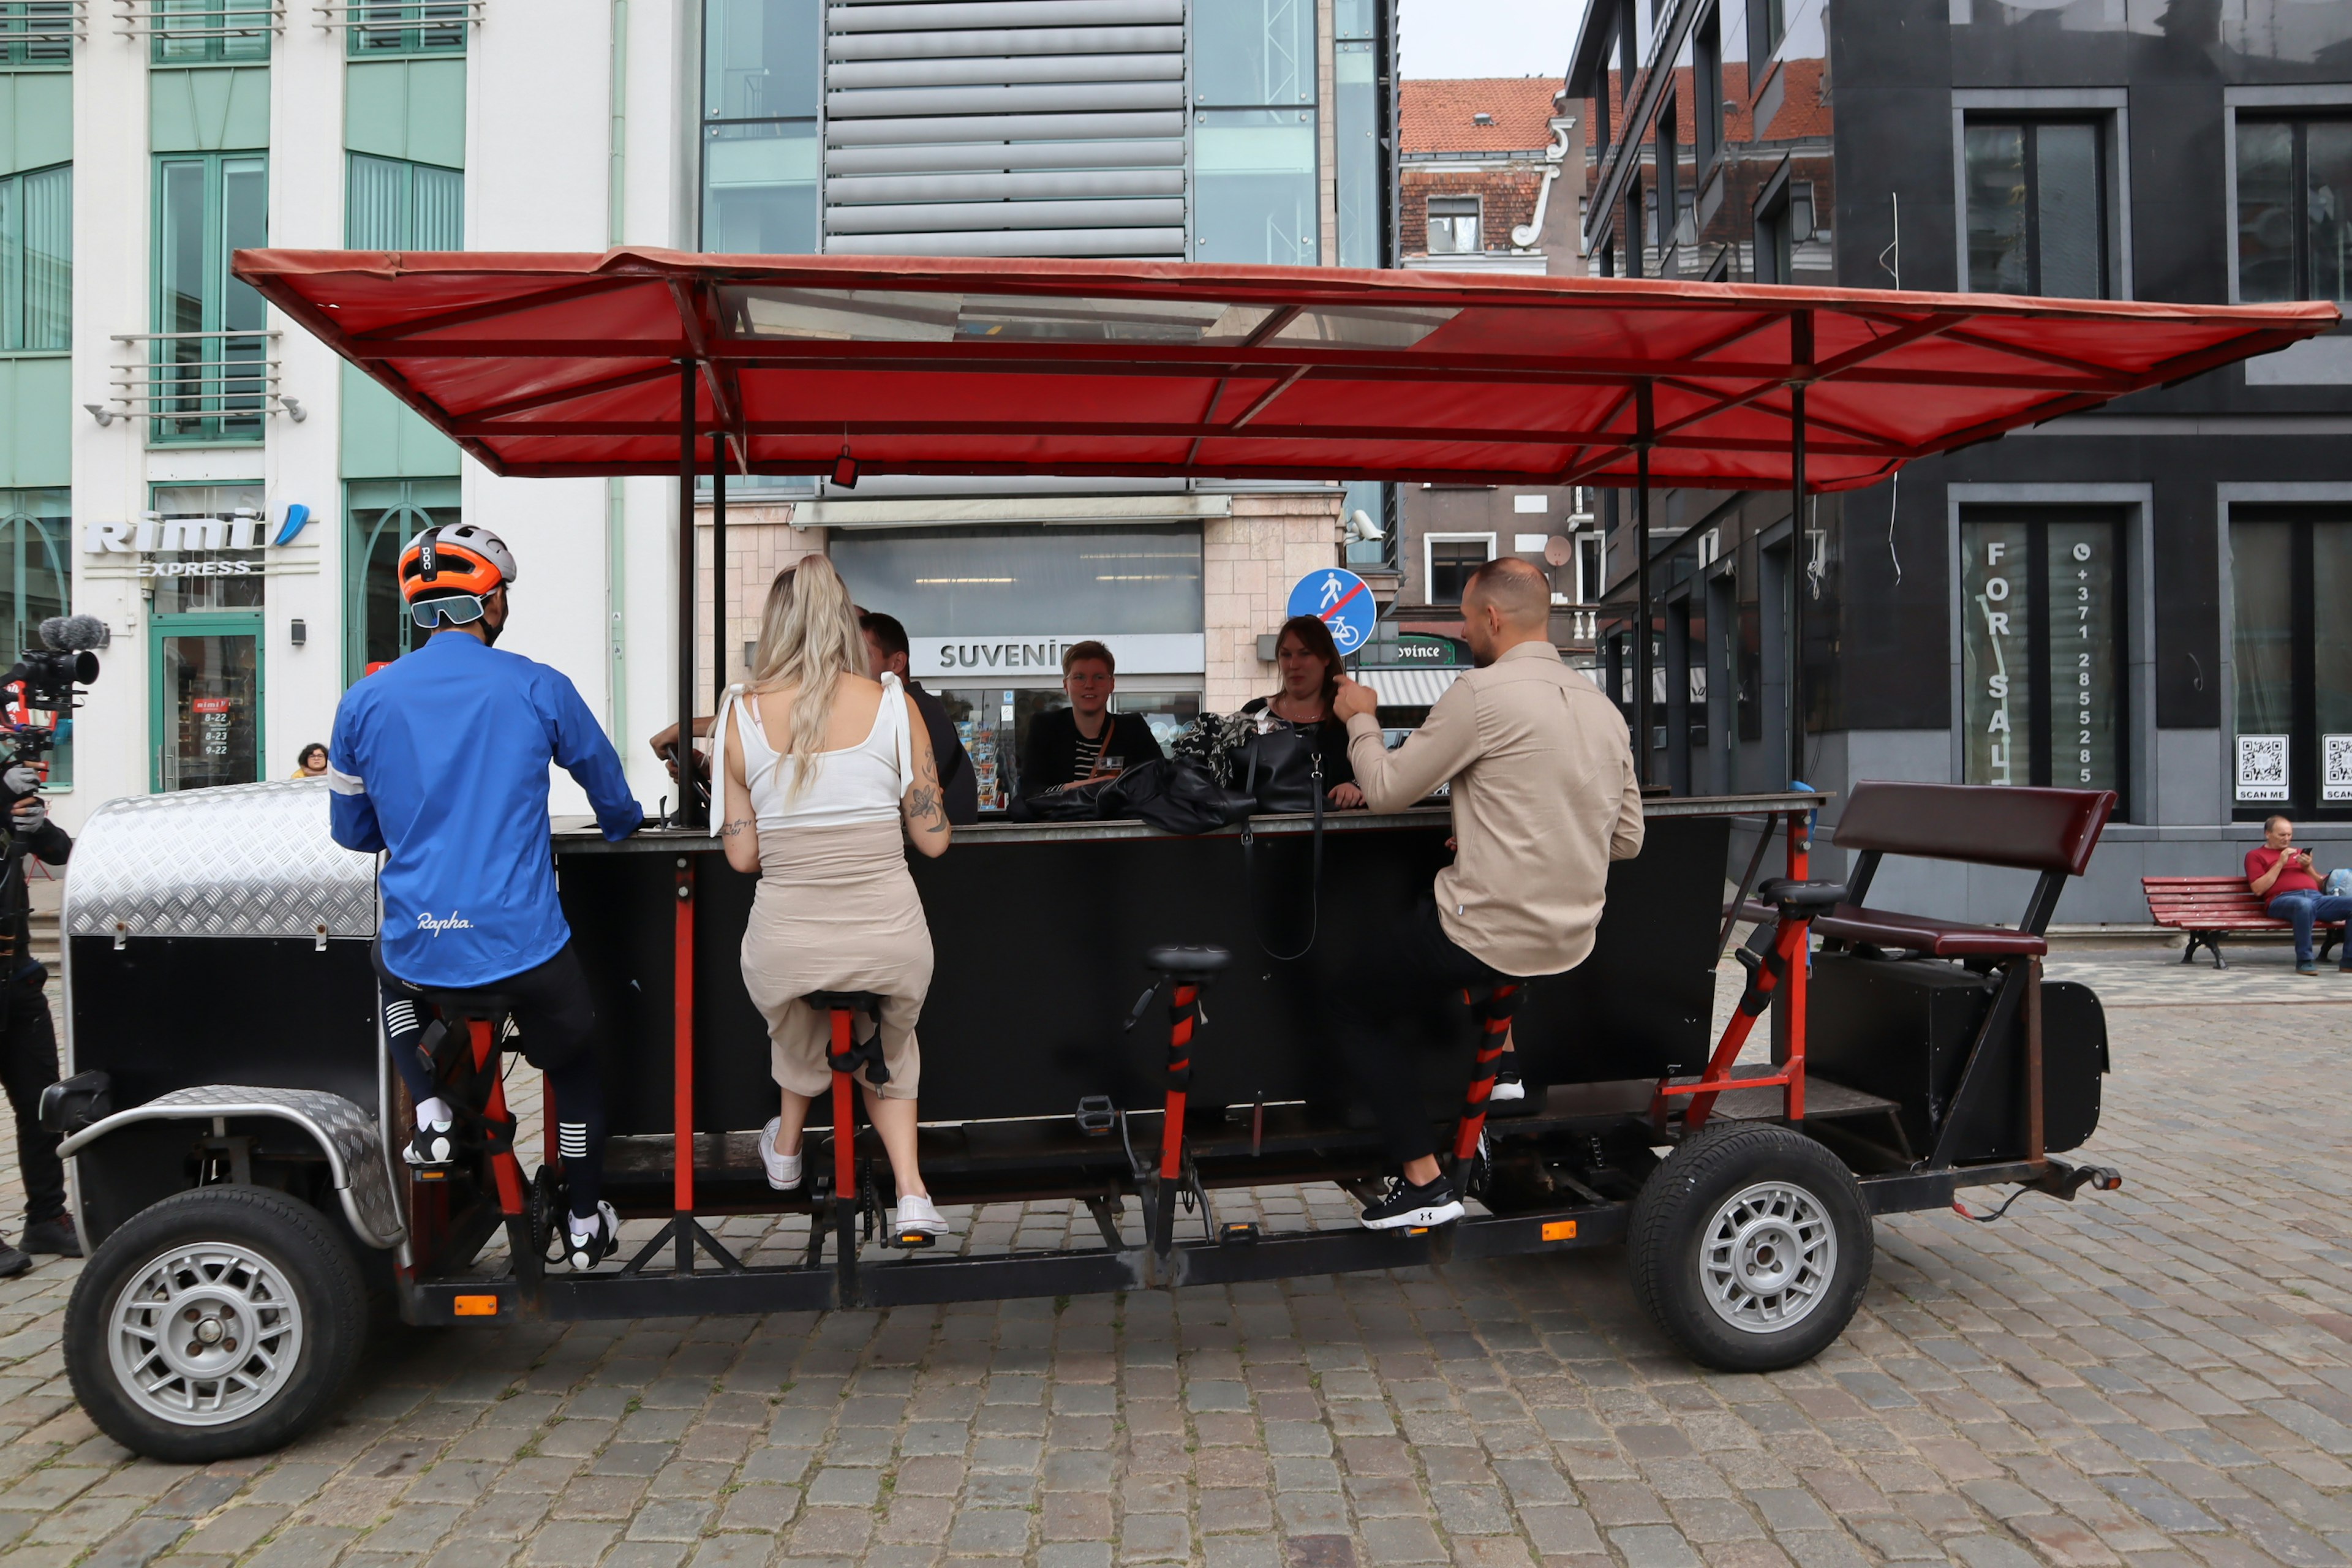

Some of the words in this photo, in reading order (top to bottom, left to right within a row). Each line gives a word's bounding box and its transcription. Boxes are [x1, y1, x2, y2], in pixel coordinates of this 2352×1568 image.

[136, 560, 251, 578] EXPRESS
[1986, 543, 2010, 635] FOR
[2078, 569, 2089, 639] +371
[1988, 675, 2011, 785] SAL
